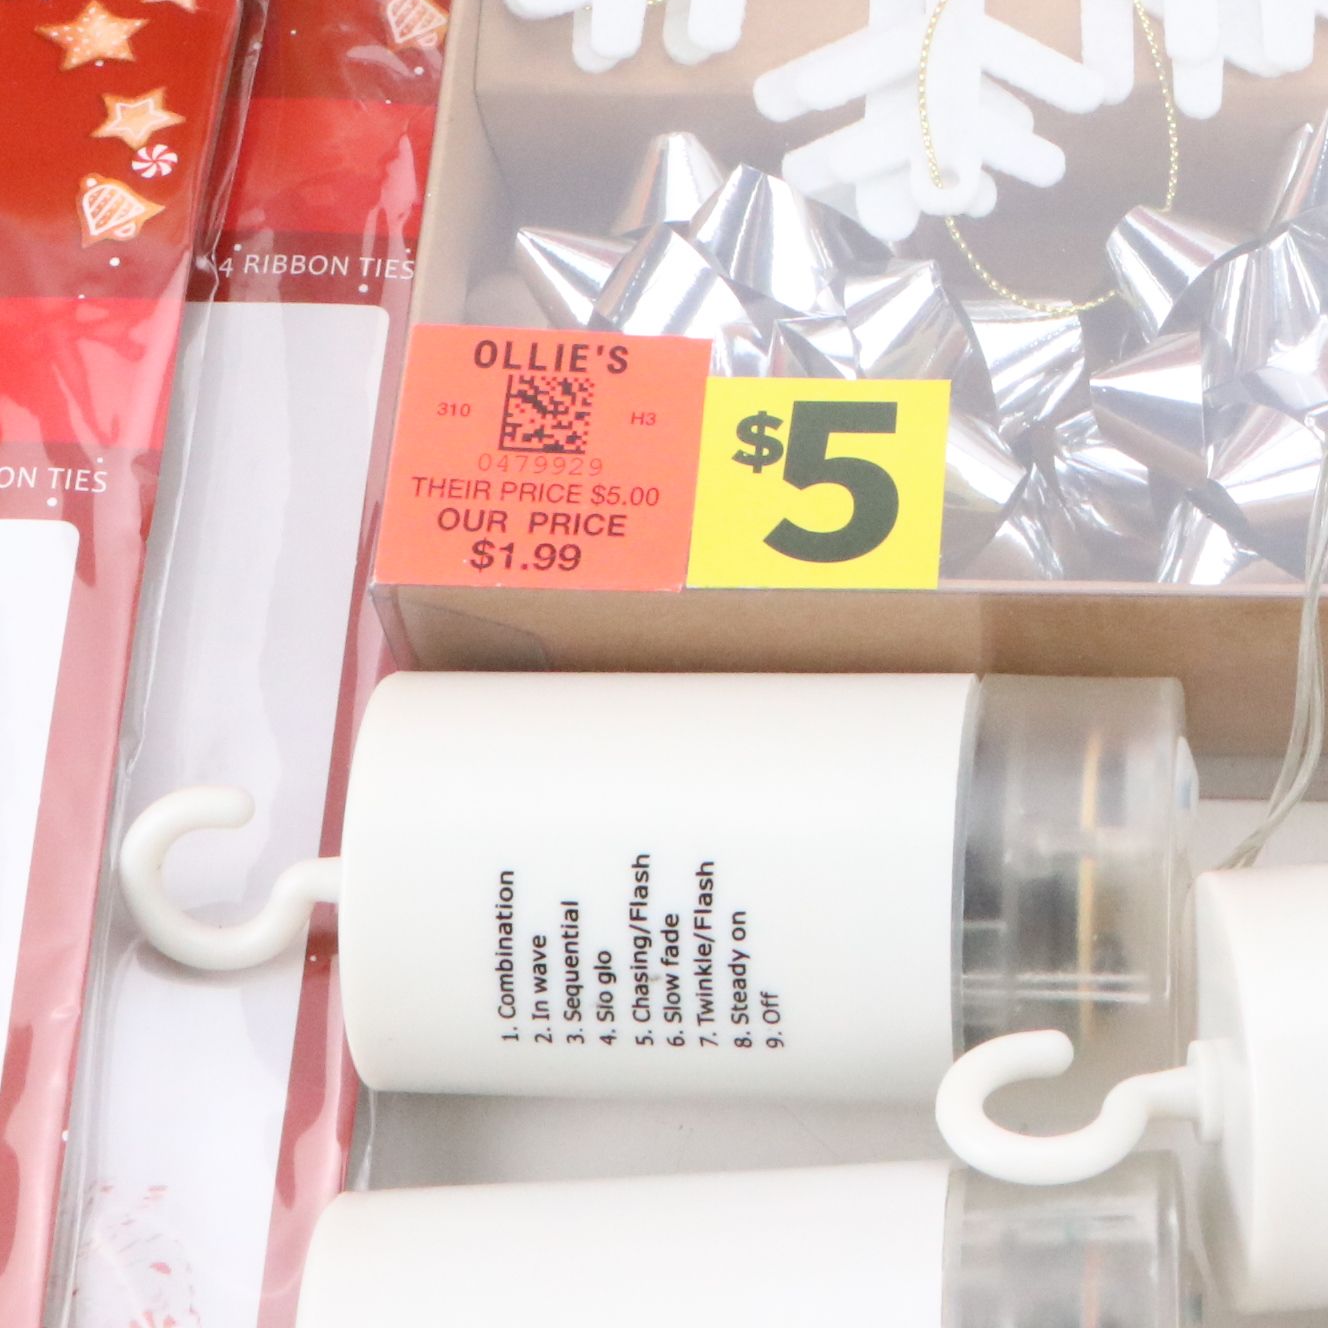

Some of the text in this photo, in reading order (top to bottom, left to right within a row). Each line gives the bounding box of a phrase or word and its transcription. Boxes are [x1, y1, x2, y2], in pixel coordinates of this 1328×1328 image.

[219, 253, 415, 280] 4 RIBBON TIES
[474, 339, 629, 375] OLLIE'S
[437, 402, 472, 418] 310
[630, 412, 657, 426] H3
[47, 467, 108, 493] TIES
[411, 475, 660, 506] THEIR PRICE $5.00
[477, 452, 604, 477] 0479929
[732, 401, 900, 563] $5
[437, 507, 628, 537] OUR PRICE
[469, 537, 582, 573] $1.99
[496, 869, 519, 1043] 1. Combination
[561, 900, 584, 1045] 3. Sequential
[630, 854, 652, 1046] 5. Chasing/Flash
[694, 860, 718, 1048] 7. Twinkle/Flash
[729, 910, 751, 1048] 8. Steady on
[532, 934, 552, 1044] 2. In wave
[594, 950, 617, 1046] 4. Slo glo
[660, 913, 685, 1047] 6. Slow fade
[760, 990, 784, 1049] 9. Off
